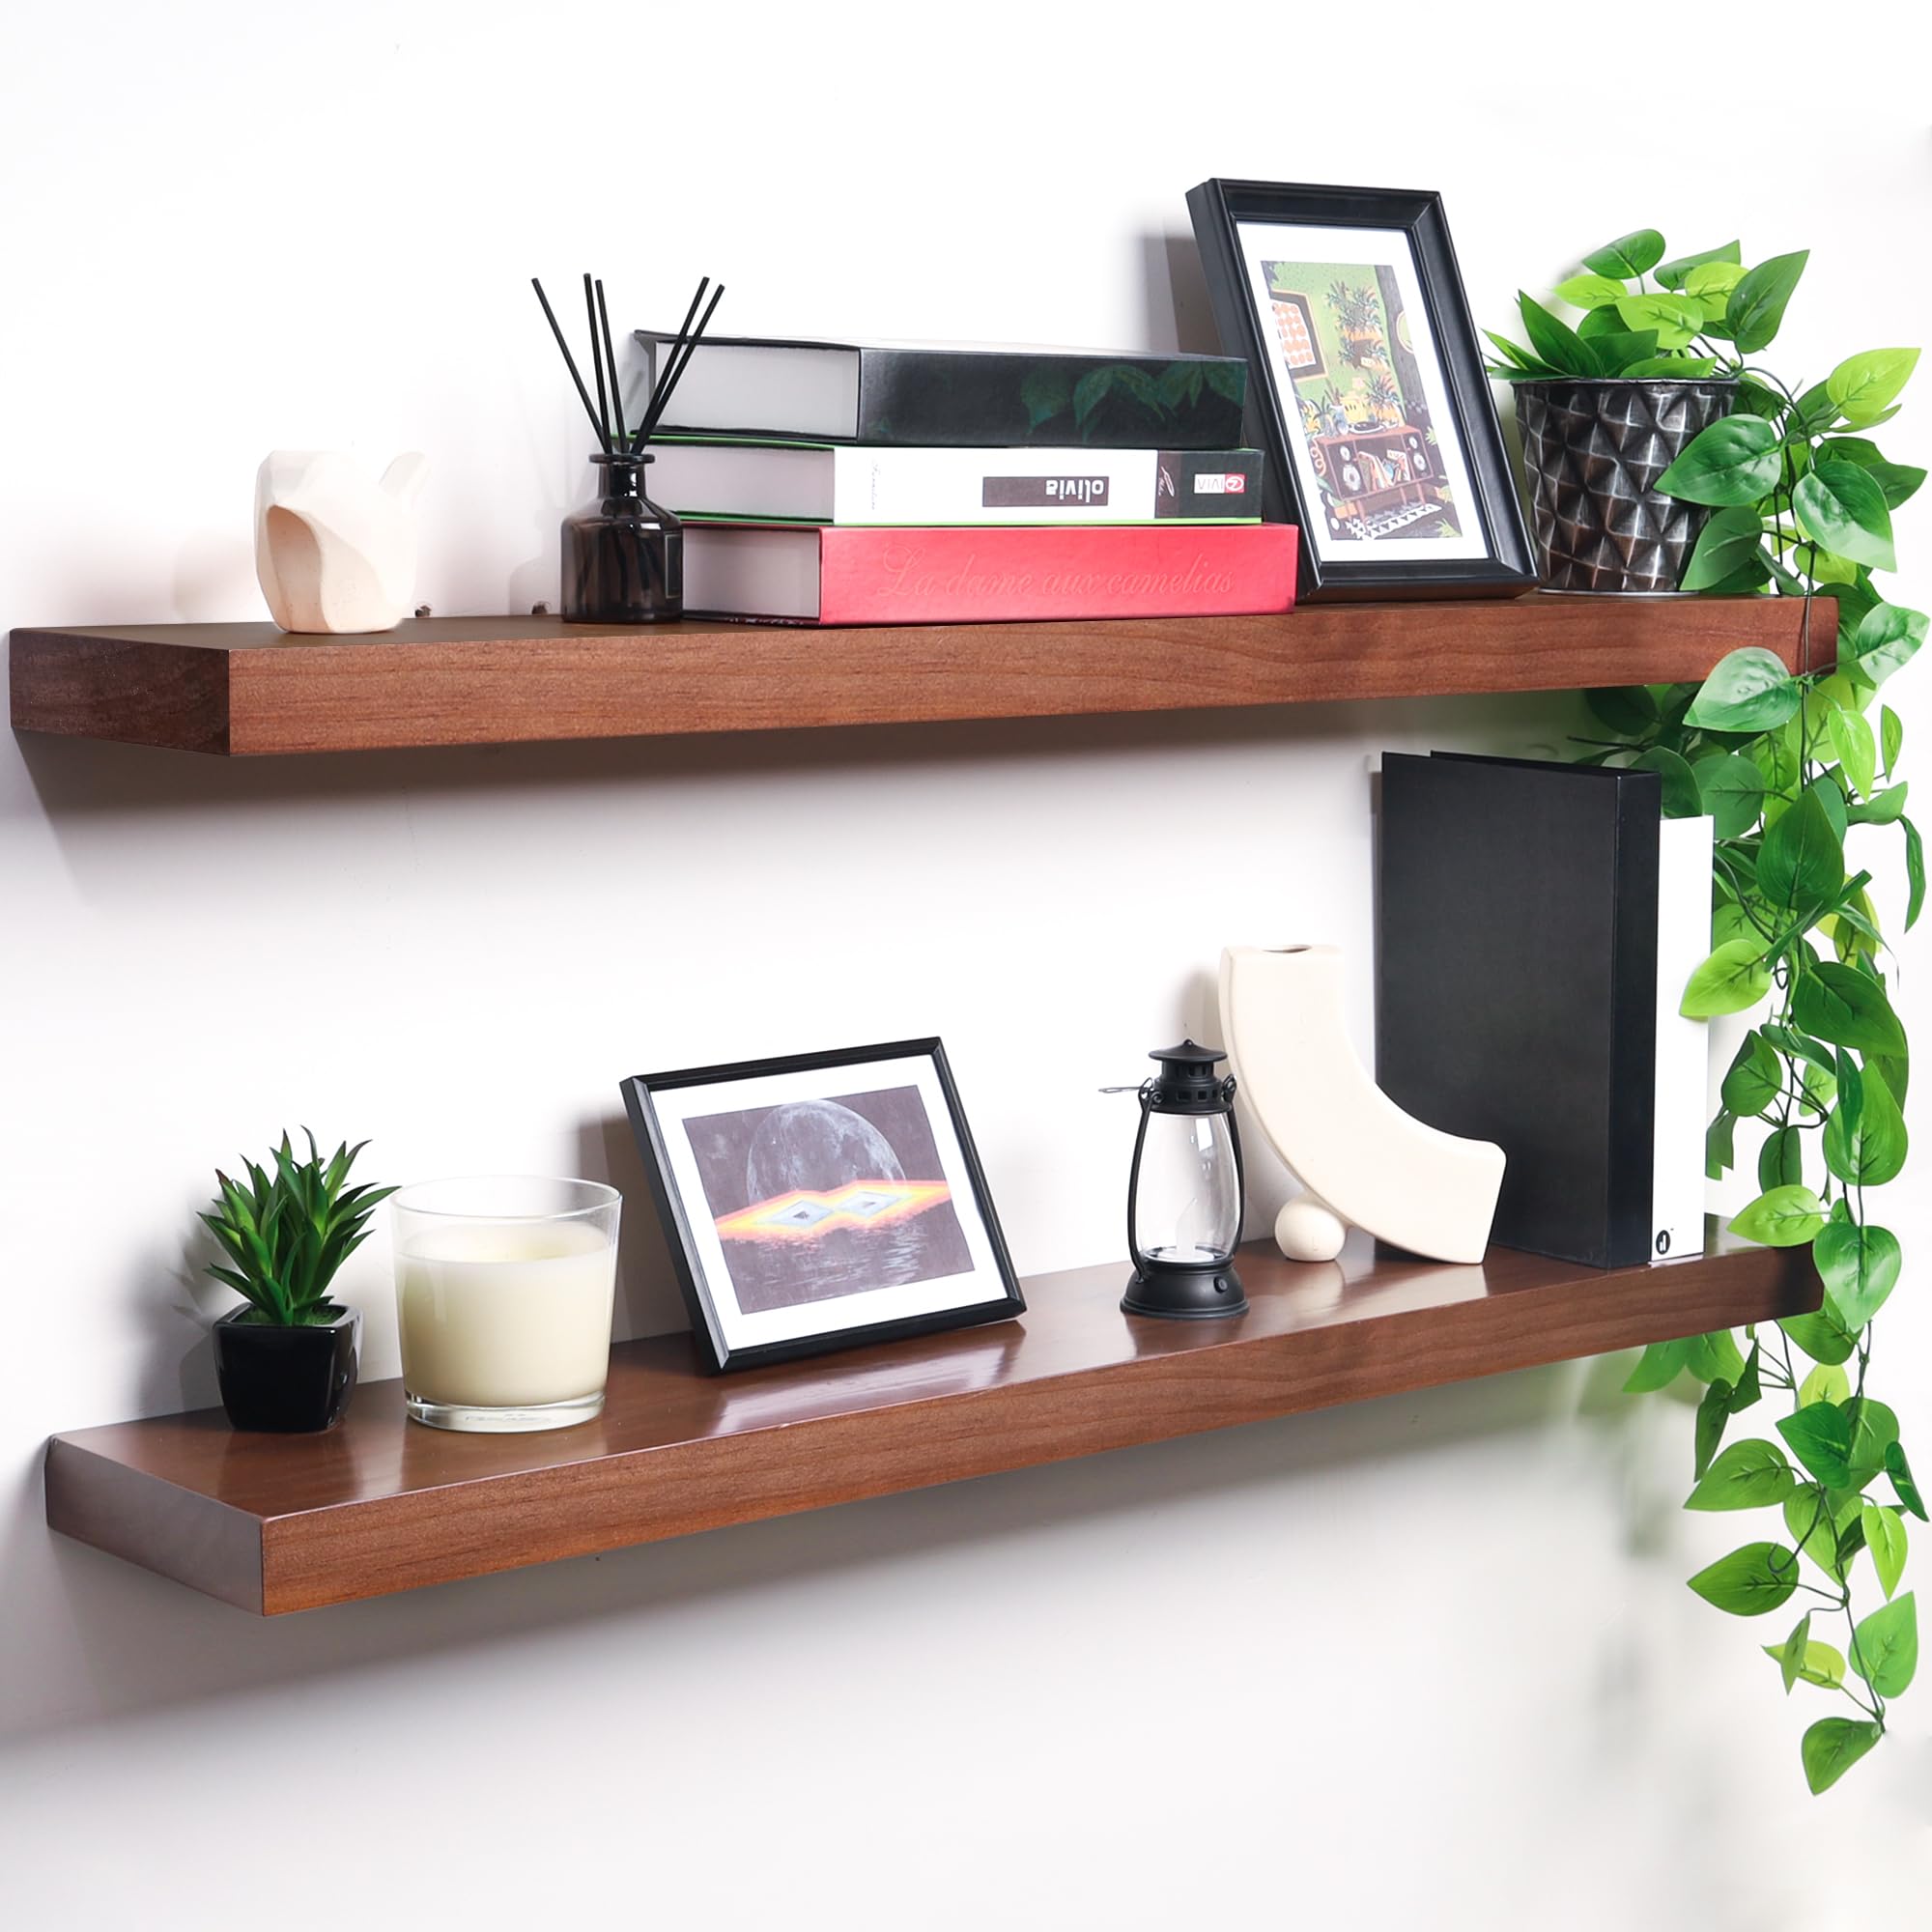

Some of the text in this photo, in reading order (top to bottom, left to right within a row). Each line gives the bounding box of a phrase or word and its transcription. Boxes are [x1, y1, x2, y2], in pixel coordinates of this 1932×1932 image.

[1046, 479, 1104, 503] olivia
[877, 542, 1236, 597] La dame aux camelias
